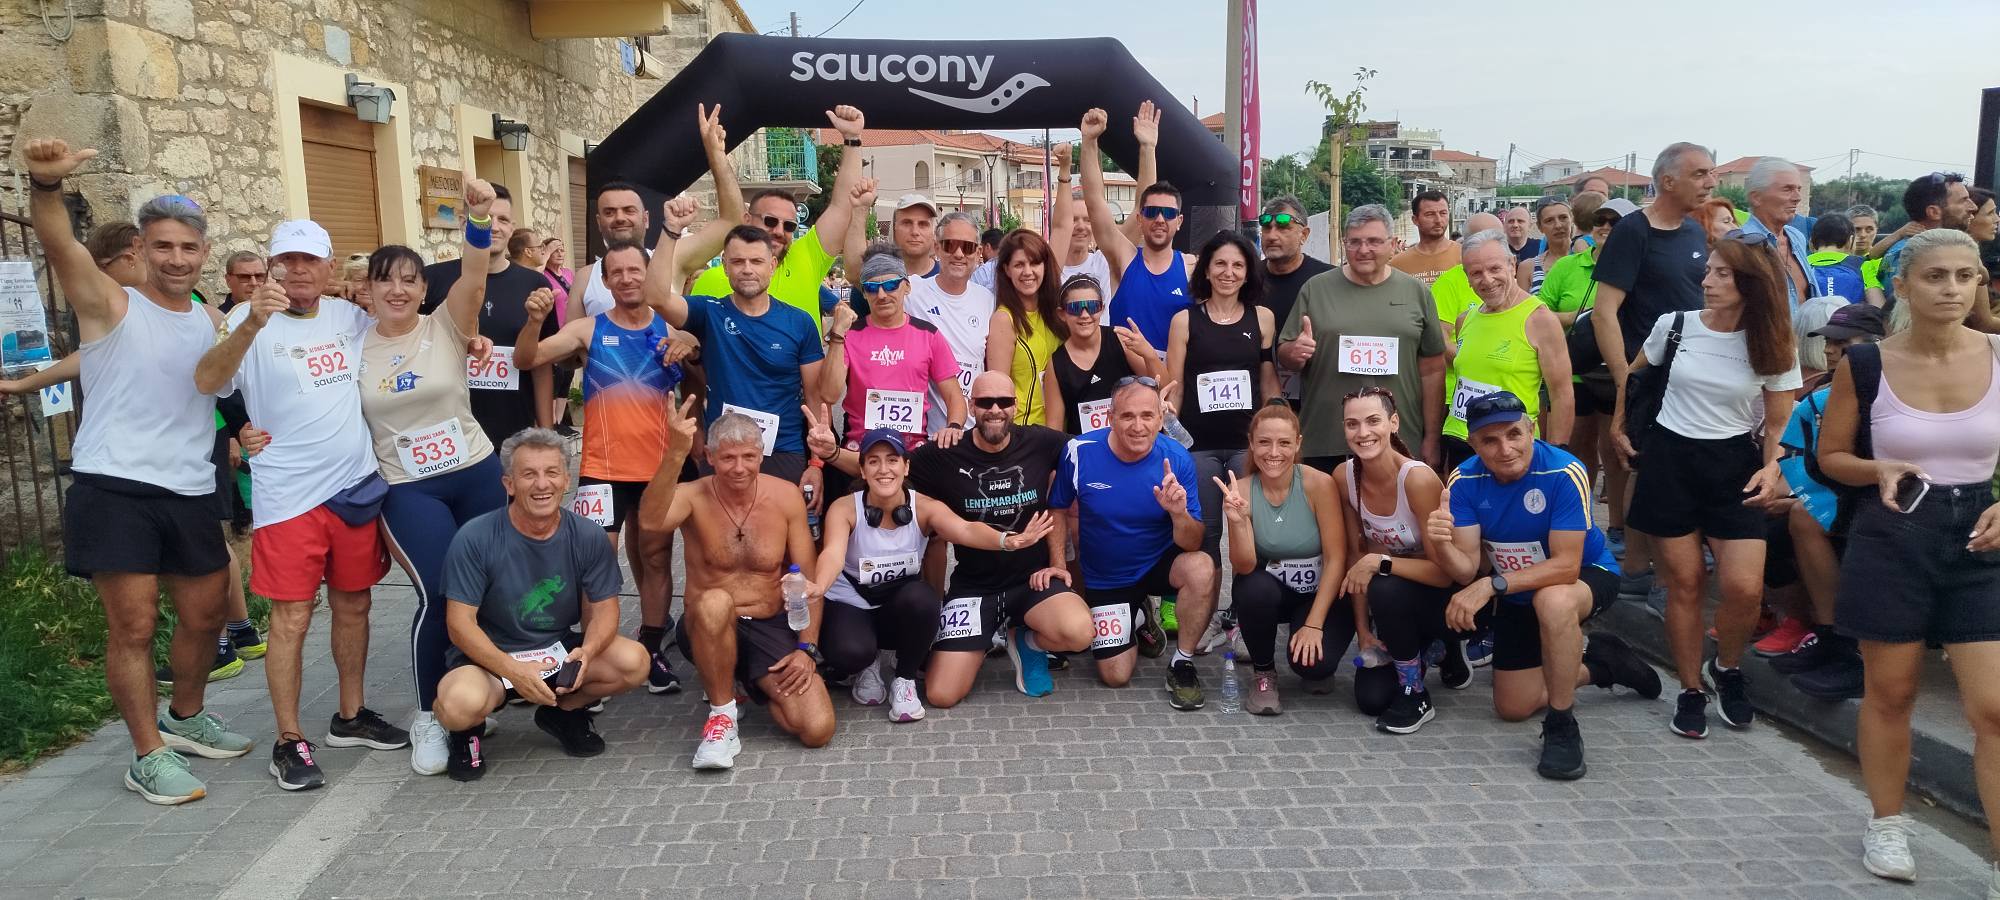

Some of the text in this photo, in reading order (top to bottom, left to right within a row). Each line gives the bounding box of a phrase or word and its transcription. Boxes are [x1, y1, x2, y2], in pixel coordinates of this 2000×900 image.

[790, 52, 995, 91] saucony
[307, 352, 348, 377] 592
[1350, 349, 1387, 365] 613
[468, 360, 509, 378] 576
[314, 373, 352, 387] saucony
[468, 380, 509, 388] saucony
[1208, 384, 1241, 401] 141
[877, 404, 913, 423] 152
[1208, 401, 1245, 410] saucony
[874, 422, 914, 432] saucony
[412, 437, 456, 465] 533
[418, 456, 460, 475] saucony
[989, 482, 1011, 491] KPMG
[574, 499, 604, 516] 604
[965, 489, 1038, 509] LENTEMARATHON
[1372, 532, 1404, 548] 641
[1495, 554, 1534, 571] 585
[871, 568, 908, 584] 064
[1278, 570, 1316, 585] 149
[940, 610, 970, 631] 042
